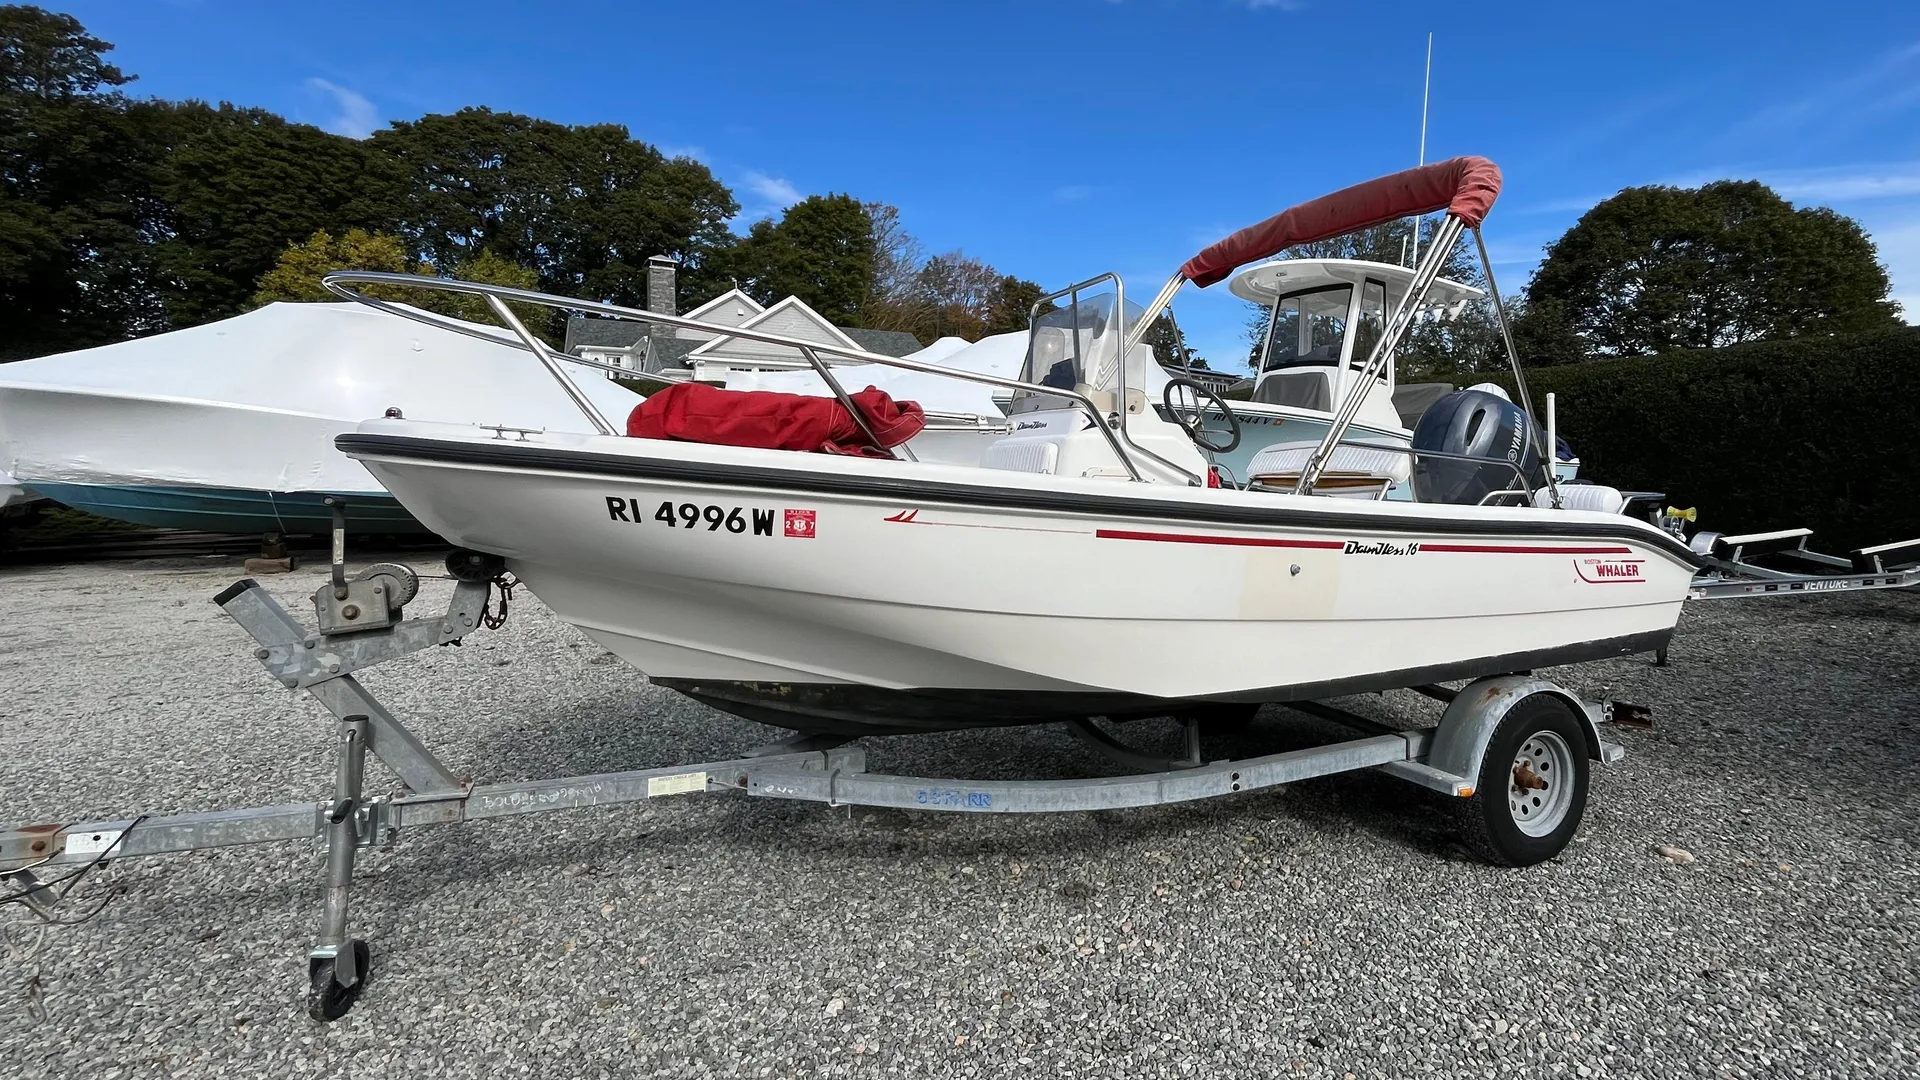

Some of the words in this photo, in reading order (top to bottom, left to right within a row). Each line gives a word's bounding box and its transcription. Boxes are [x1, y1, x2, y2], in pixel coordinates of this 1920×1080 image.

[1511, 411, 1523, 450] YAMAHA
[605, 496, 642, 523] RI
[1405, 542, 1419, 556] 16
[1596, 564, 1639, 577] WHALER
[1804, 580, 1849, 591] VENTURE
